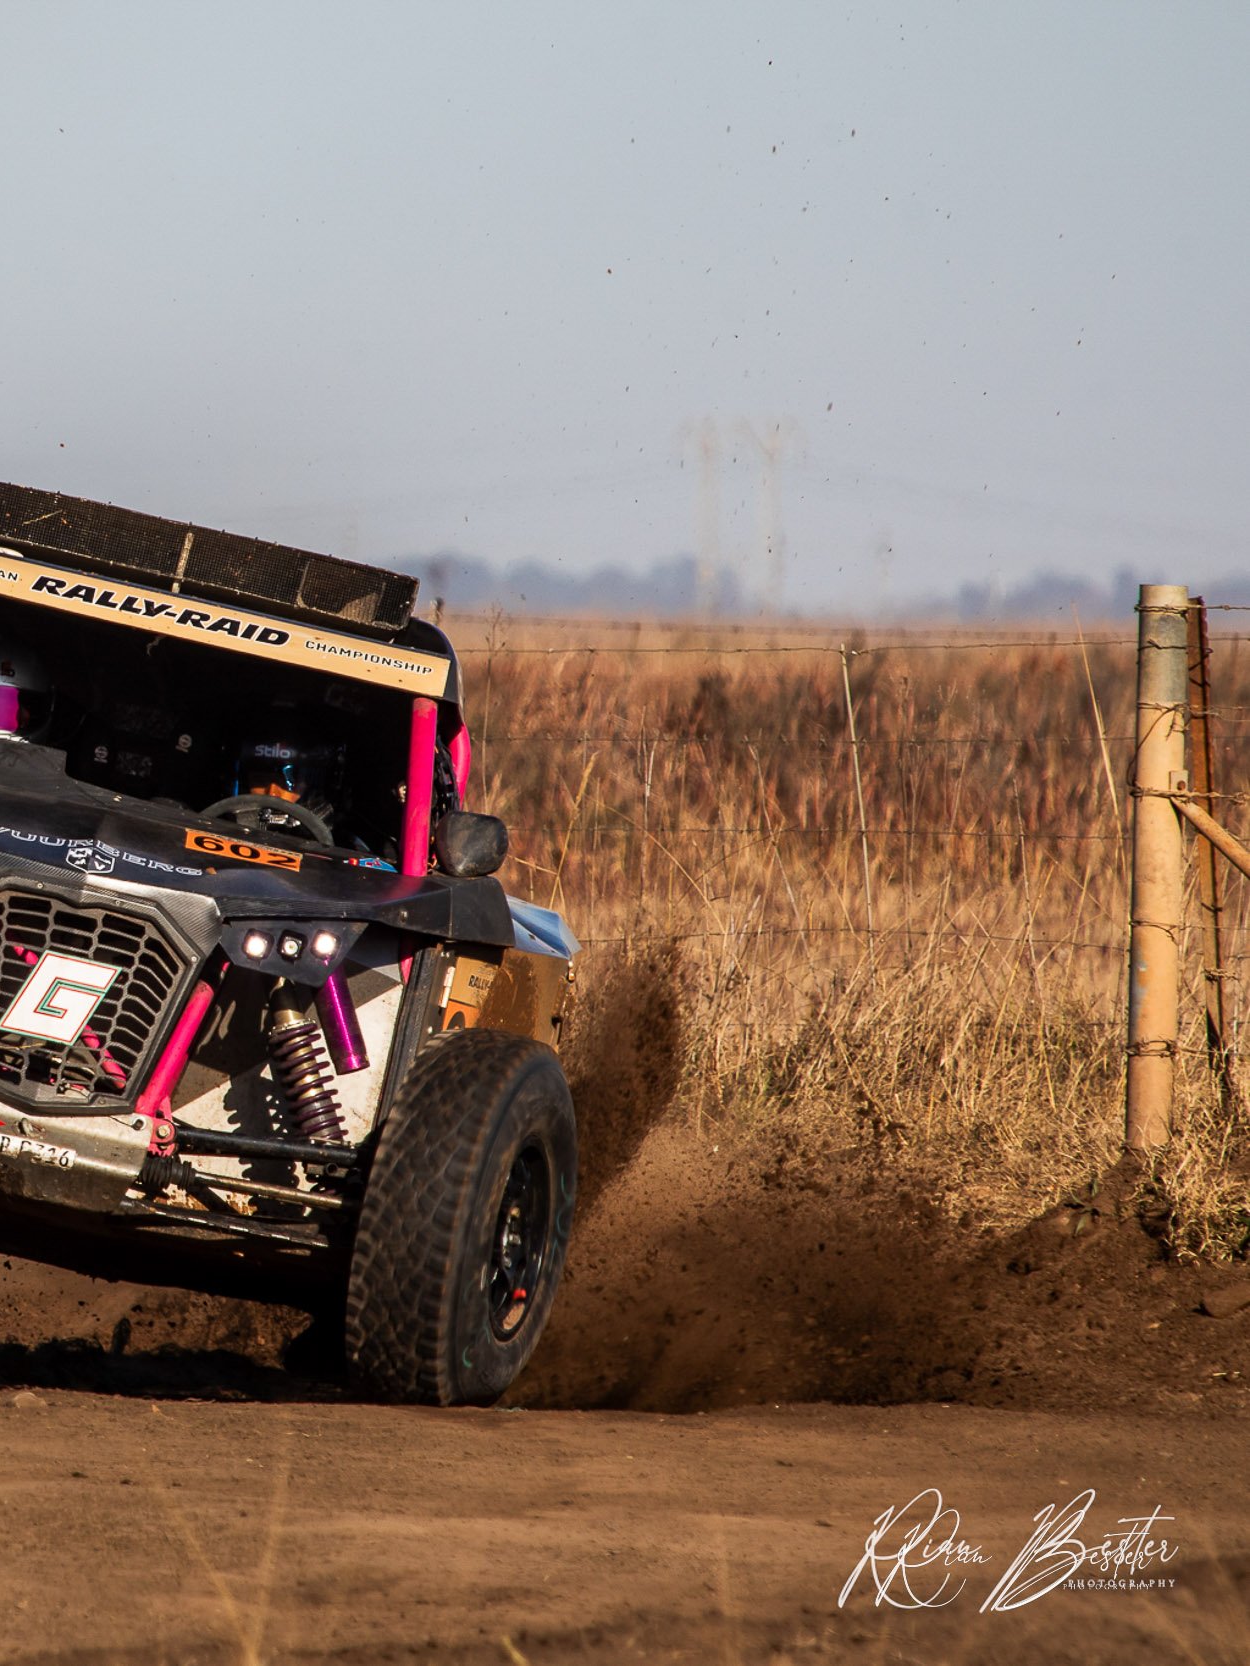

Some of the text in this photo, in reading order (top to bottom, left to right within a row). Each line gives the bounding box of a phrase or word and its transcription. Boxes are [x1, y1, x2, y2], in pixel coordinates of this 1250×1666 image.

[31, 575, 291, 647] RALLY-RAID
[305, 640, 432, 674] CHAMPIONSHIP
[254, 742, 291, 759] Stilo
[193, 835, 298, 869] 602
